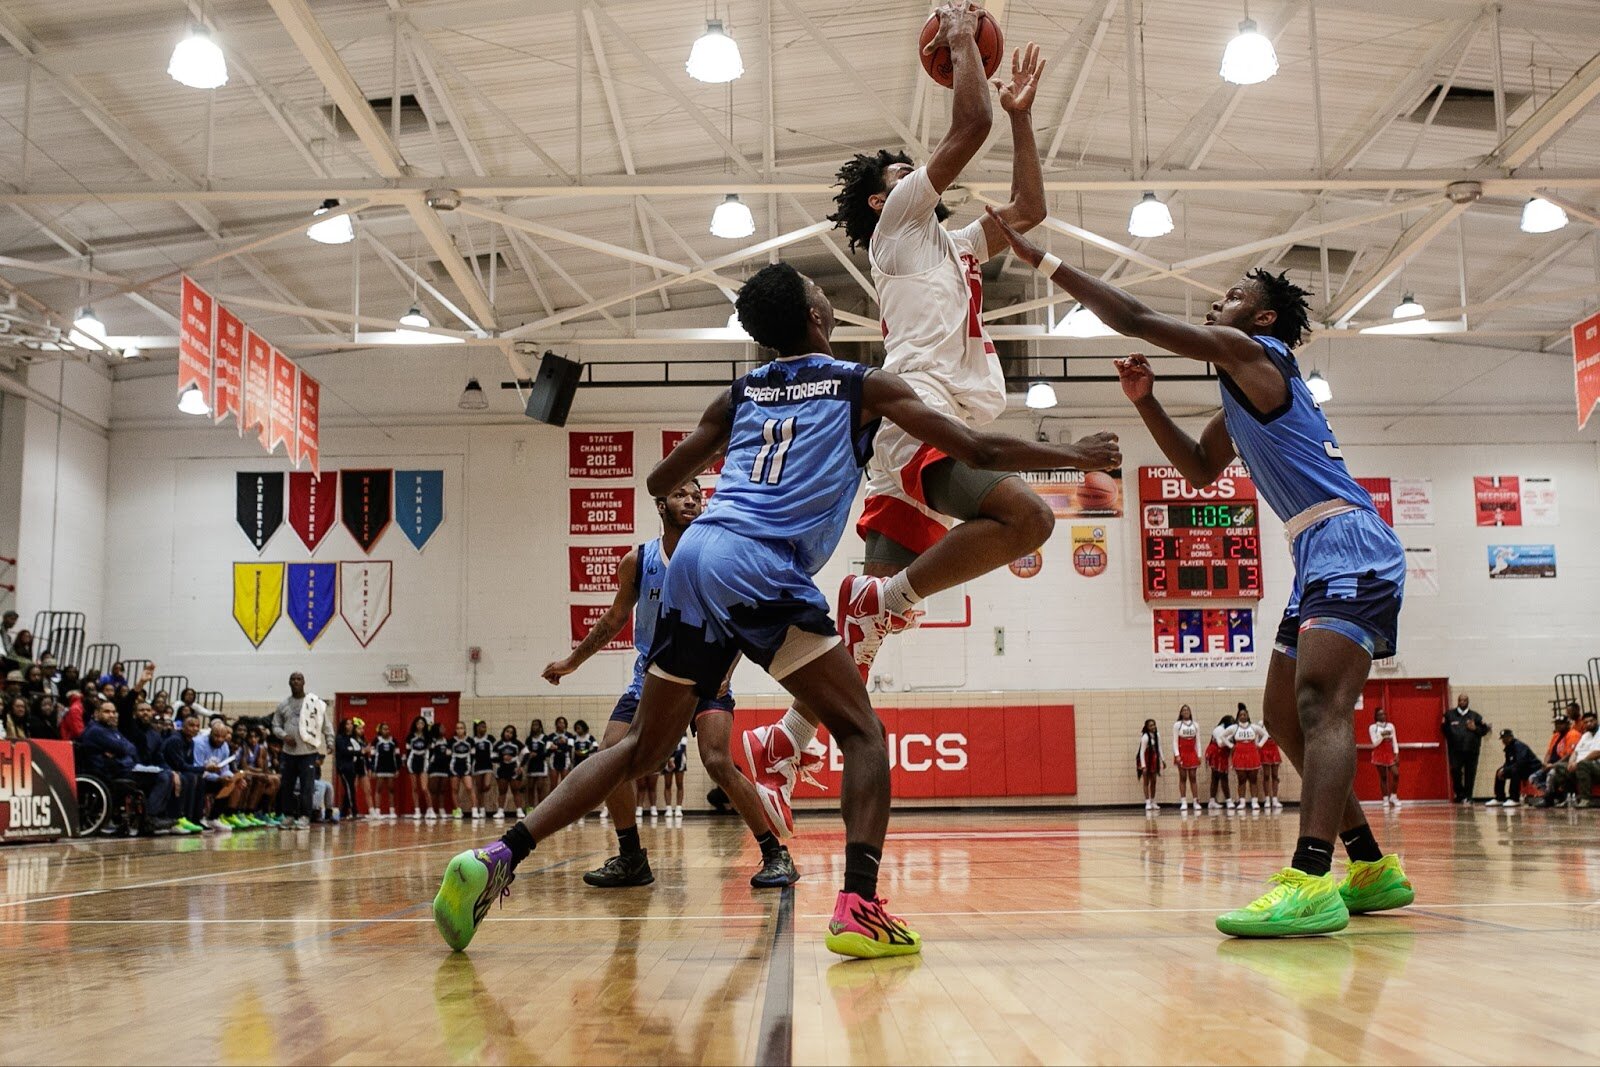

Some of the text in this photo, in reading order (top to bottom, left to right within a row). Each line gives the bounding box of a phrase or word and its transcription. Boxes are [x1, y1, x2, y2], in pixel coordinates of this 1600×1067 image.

[744, 380, 841, 401] GREEN-TORBERT
[589, 435, 613, 443] STATE
[580, 445, 622, 453] CHAMPIONS
[750, 416, 797, 485] 11
[587, 454, 616, 466] 2012
[570, 467, 632, 475] BOYS BASKETBALL
[1020, 471, 1085, 483] RATULATIONS
[590, 491, 614, 499] STATE
[1162, 479, 1236, 499] BUCS
[582, 501, 622, 509] CHAMPIONS
[588, 510, 616, 522] 2013
[1192, 506, 1231, 527] 1:06
[571, 523, 633, 531] BOYS BASKETBALL
[1226, 528, 1254, 536] GUEST
[1230, 537, 1257, 558] 29
[581, 555, 620, 563] CHAMPIONS
[586, 563, 616, 575] 2015
[592, 575, 611, 583] BOYS
[1153, 568, 1165, 589] 2
[1247, 567, 1258, 588] 3
[579, 583, 619, 591] BASKETBAL
[589, 608, 609, 616] STAT
[9, 795, 51, 828] BUCS
